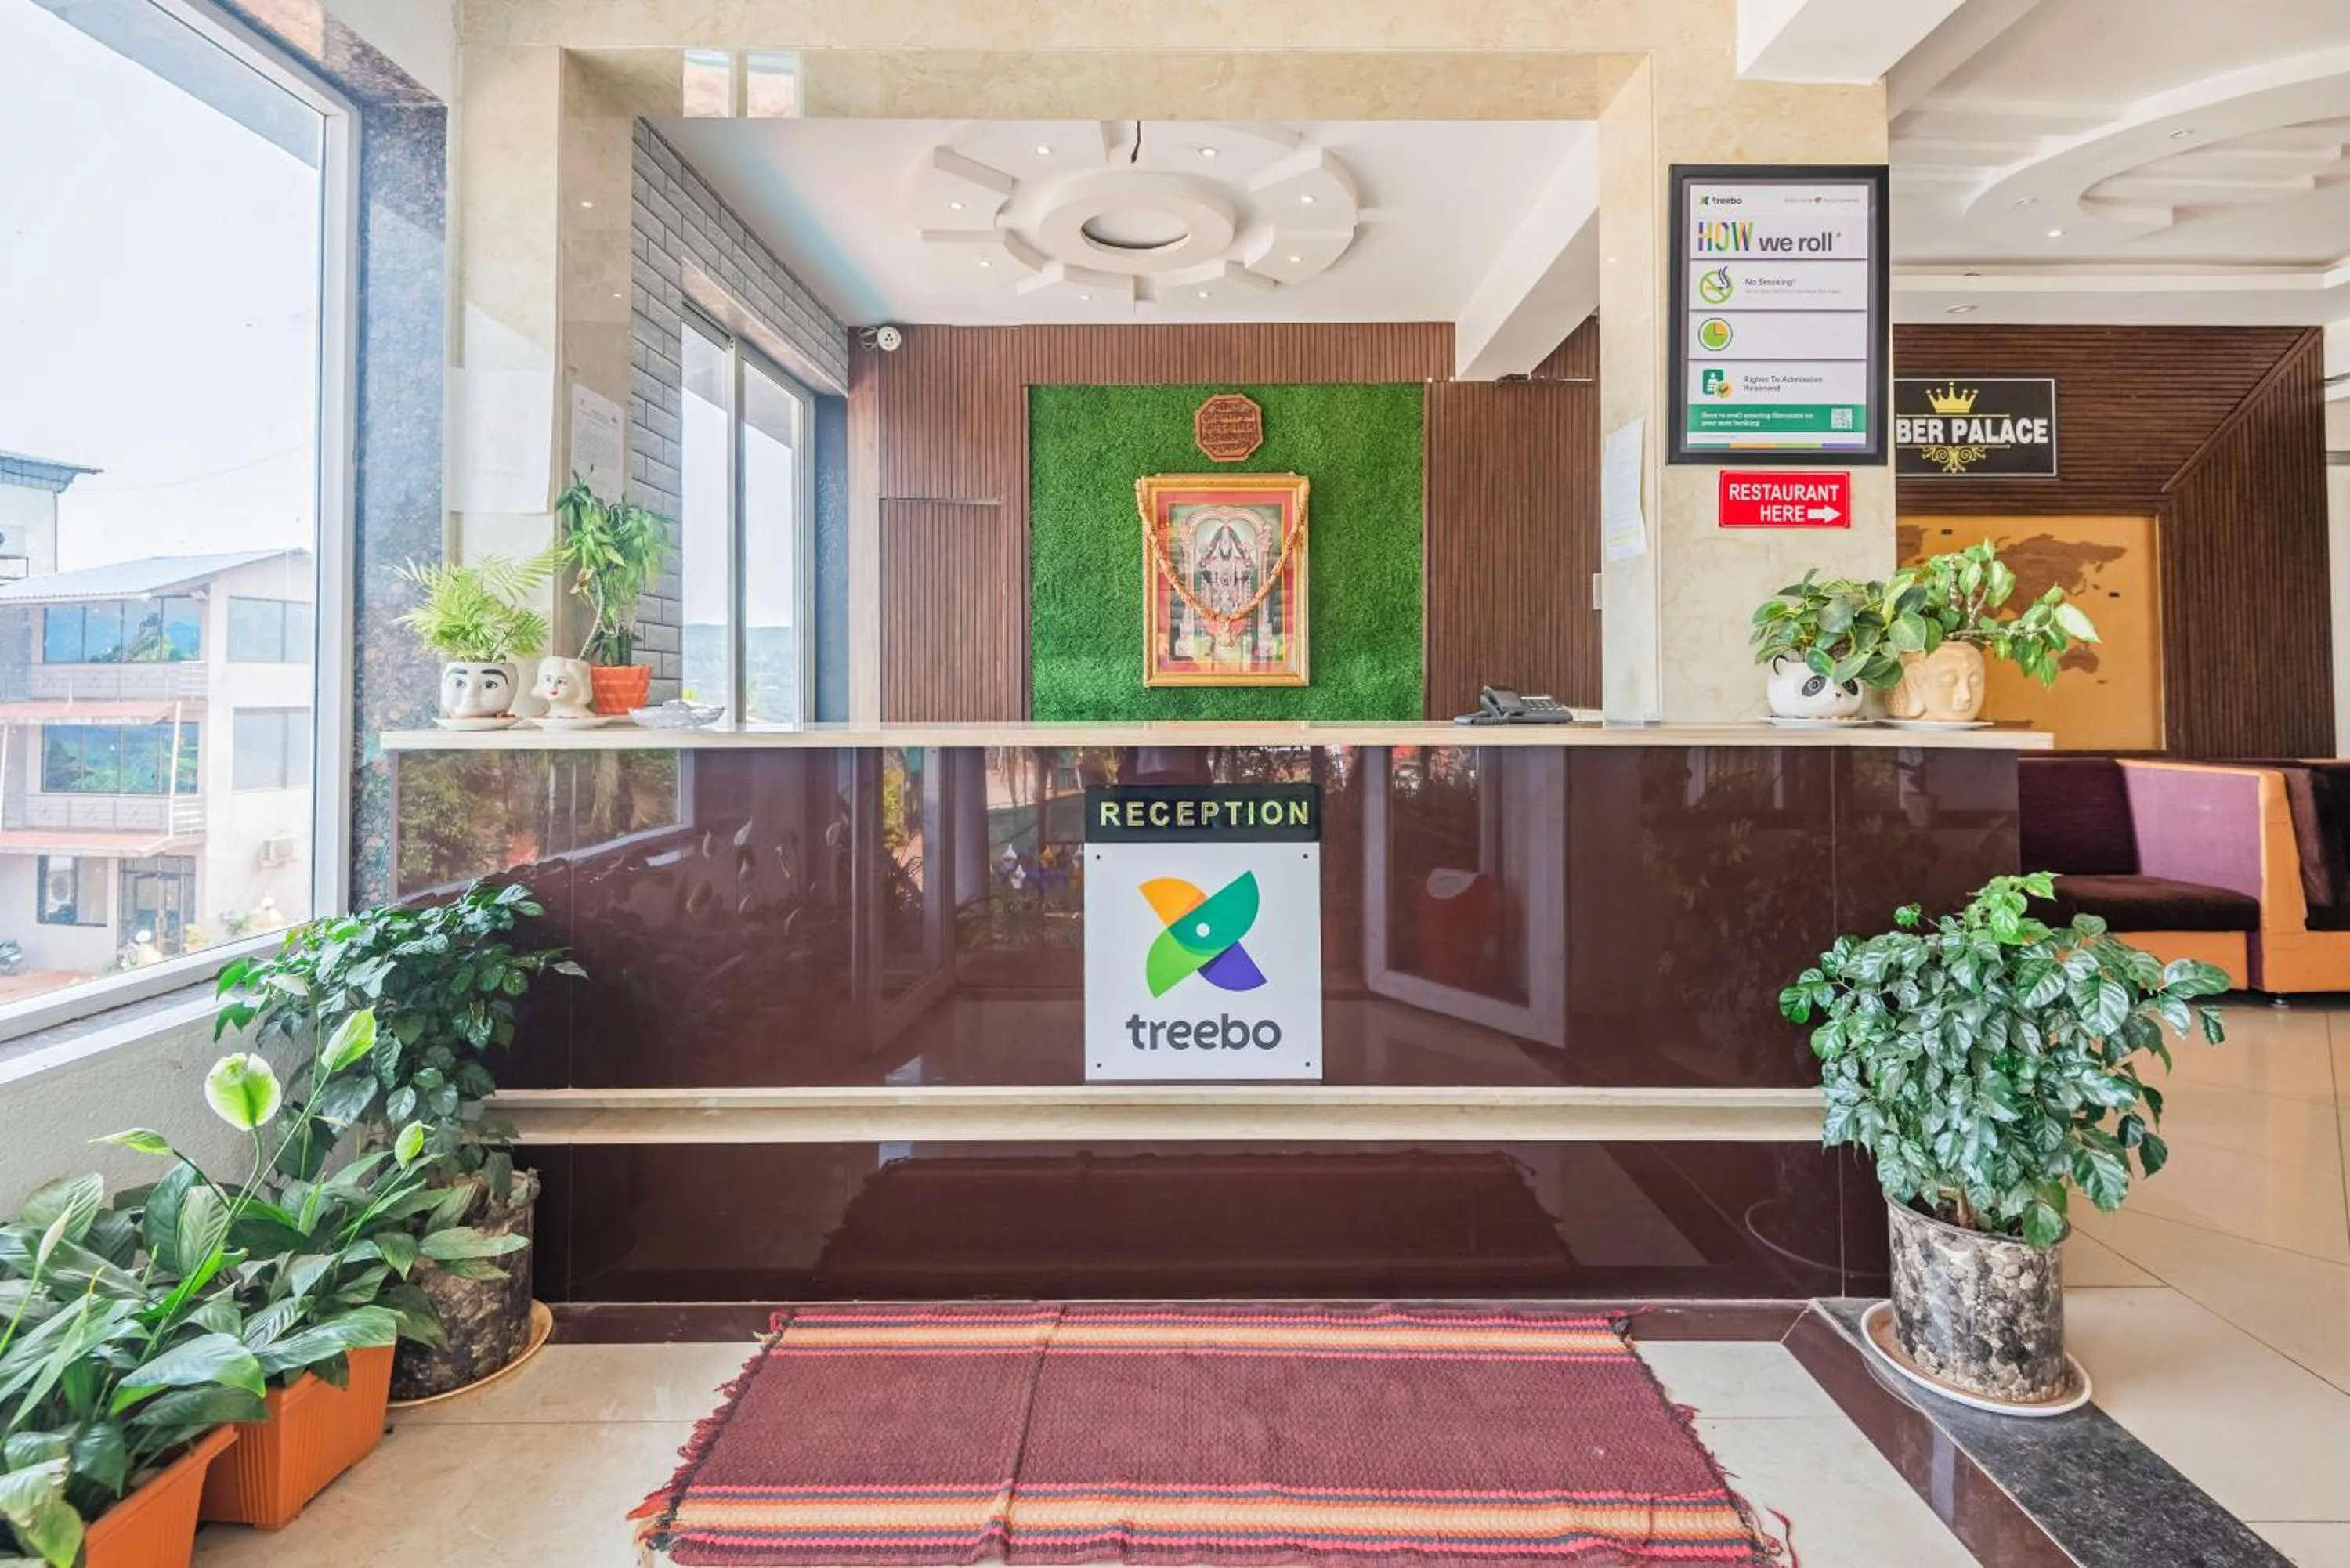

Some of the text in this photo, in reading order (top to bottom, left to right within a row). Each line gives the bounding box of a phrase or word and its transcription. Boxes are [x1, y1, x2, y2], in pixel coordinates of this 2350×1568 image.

[1697, 222, 1754, 251] HOW
[1759, 237, 1793, 251] we
[1896, 417, 2049, 444] BER PALACE
[1729, 483, 1839, 502] RESTAURANT
[1760, 504, 1806, 522] HERE
[1099, 800, 1310, 828] RECEPTION
[1126, 1013, 1282, 1050] treebo
